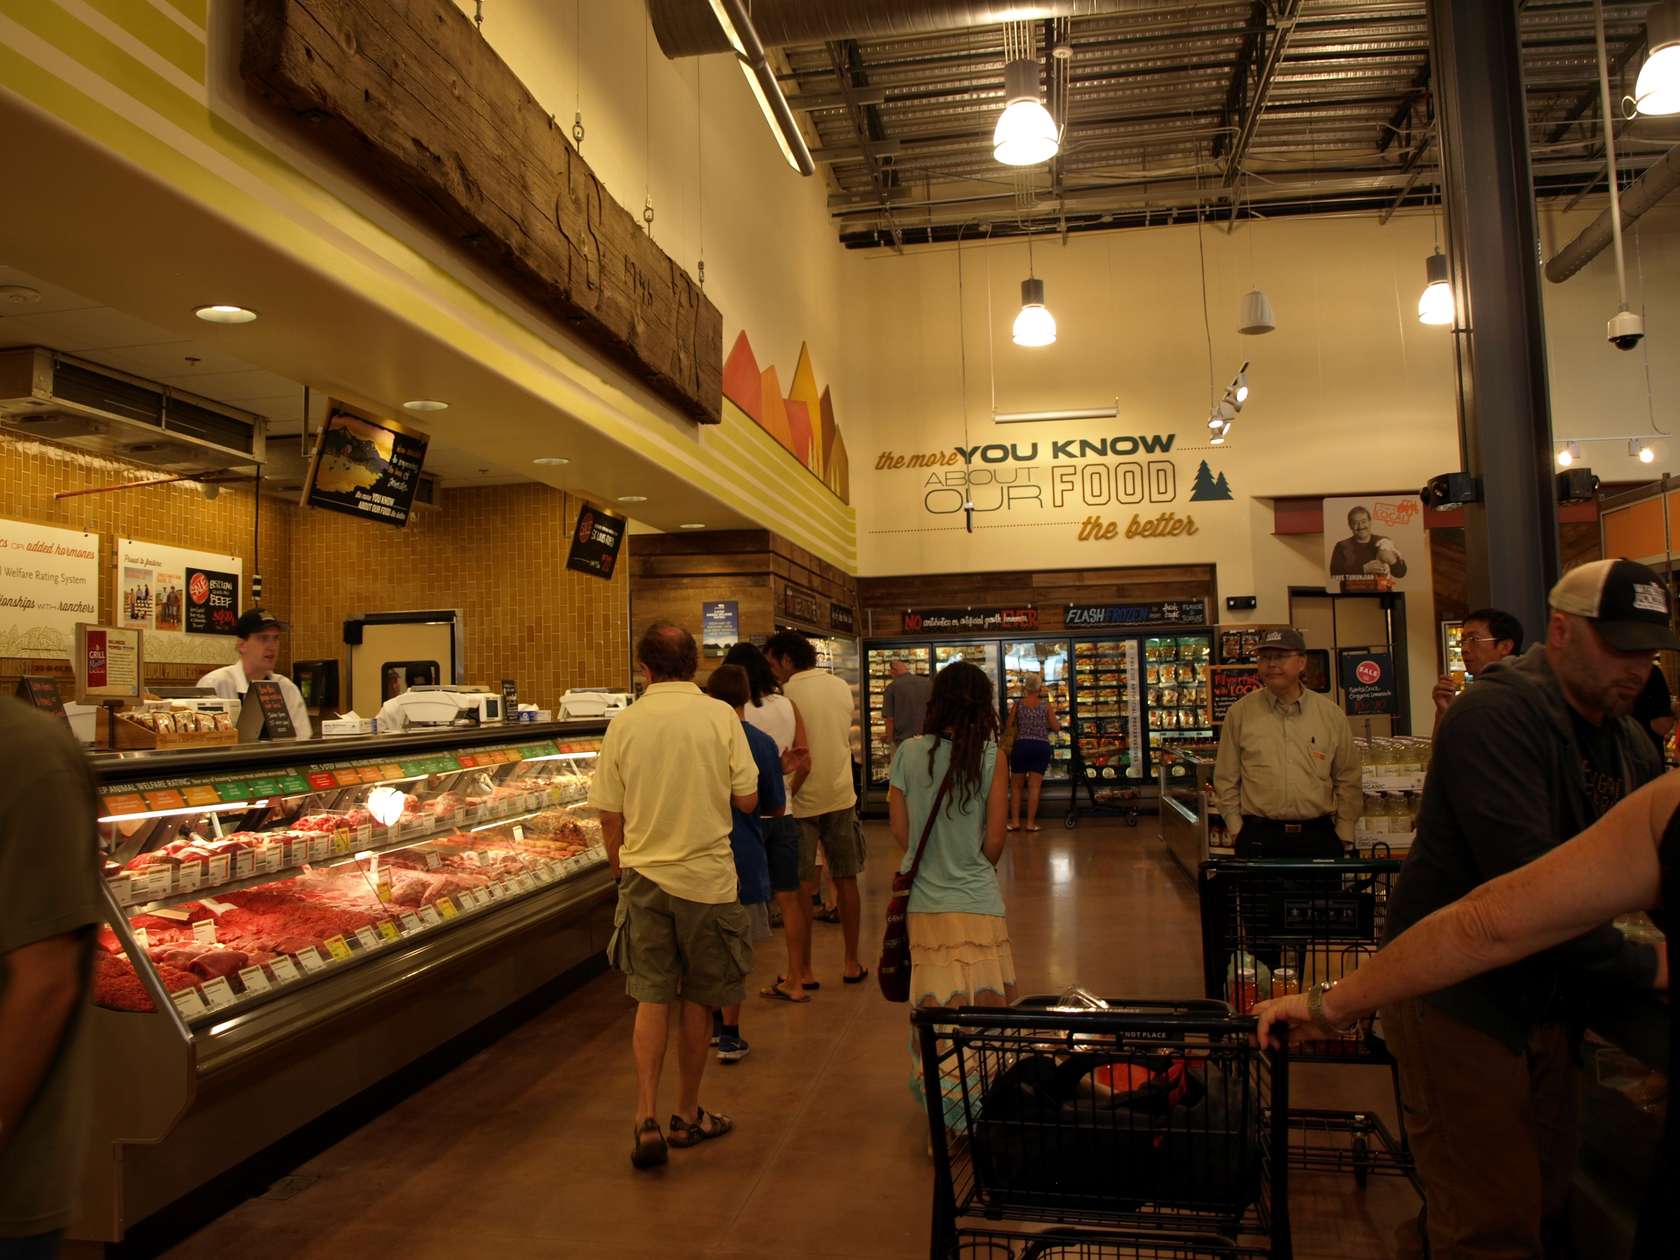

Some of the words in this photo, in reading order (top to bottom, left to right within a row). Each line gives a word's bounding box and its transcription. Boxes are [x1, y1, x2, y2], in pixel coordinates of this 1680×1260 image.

[874, 451, 910, 471] the
[909, 453, 958, 470] more
[954, 441, 1039, 465] YOU
[1051, 433, 1176, 461] KNOW
[924, 466, 1041, 488] ABOUT
[924, 485, 1044, 515] OUR
[1052, 460, 1177, 508] FOOD
[1077, 514, 1118, 542] the
[1124, 511, 1199, 539] better
[25, 541, 53, 554] added
[55, 543, 95, 560] hormones
[4, 567, 34, 579] Welfare
[35, 570, 59, 584] Rating
[60, 573, 87, 585] System
[209, 594, 233, 608] BEEF
[904, 614, 922, 630] NO
[1066, 608, 1105, 624] FLASH
[1358, 666, 1379, 677] SALE
[110, 782, 137, 793] ANIMAL
[137, 779, 166, 791] WELFARE
[166, 776, 191, 788] RATING
[1124, 1031, 1141, 1039] NOT
[1142, 1031, 1167, 1039] PLACE
